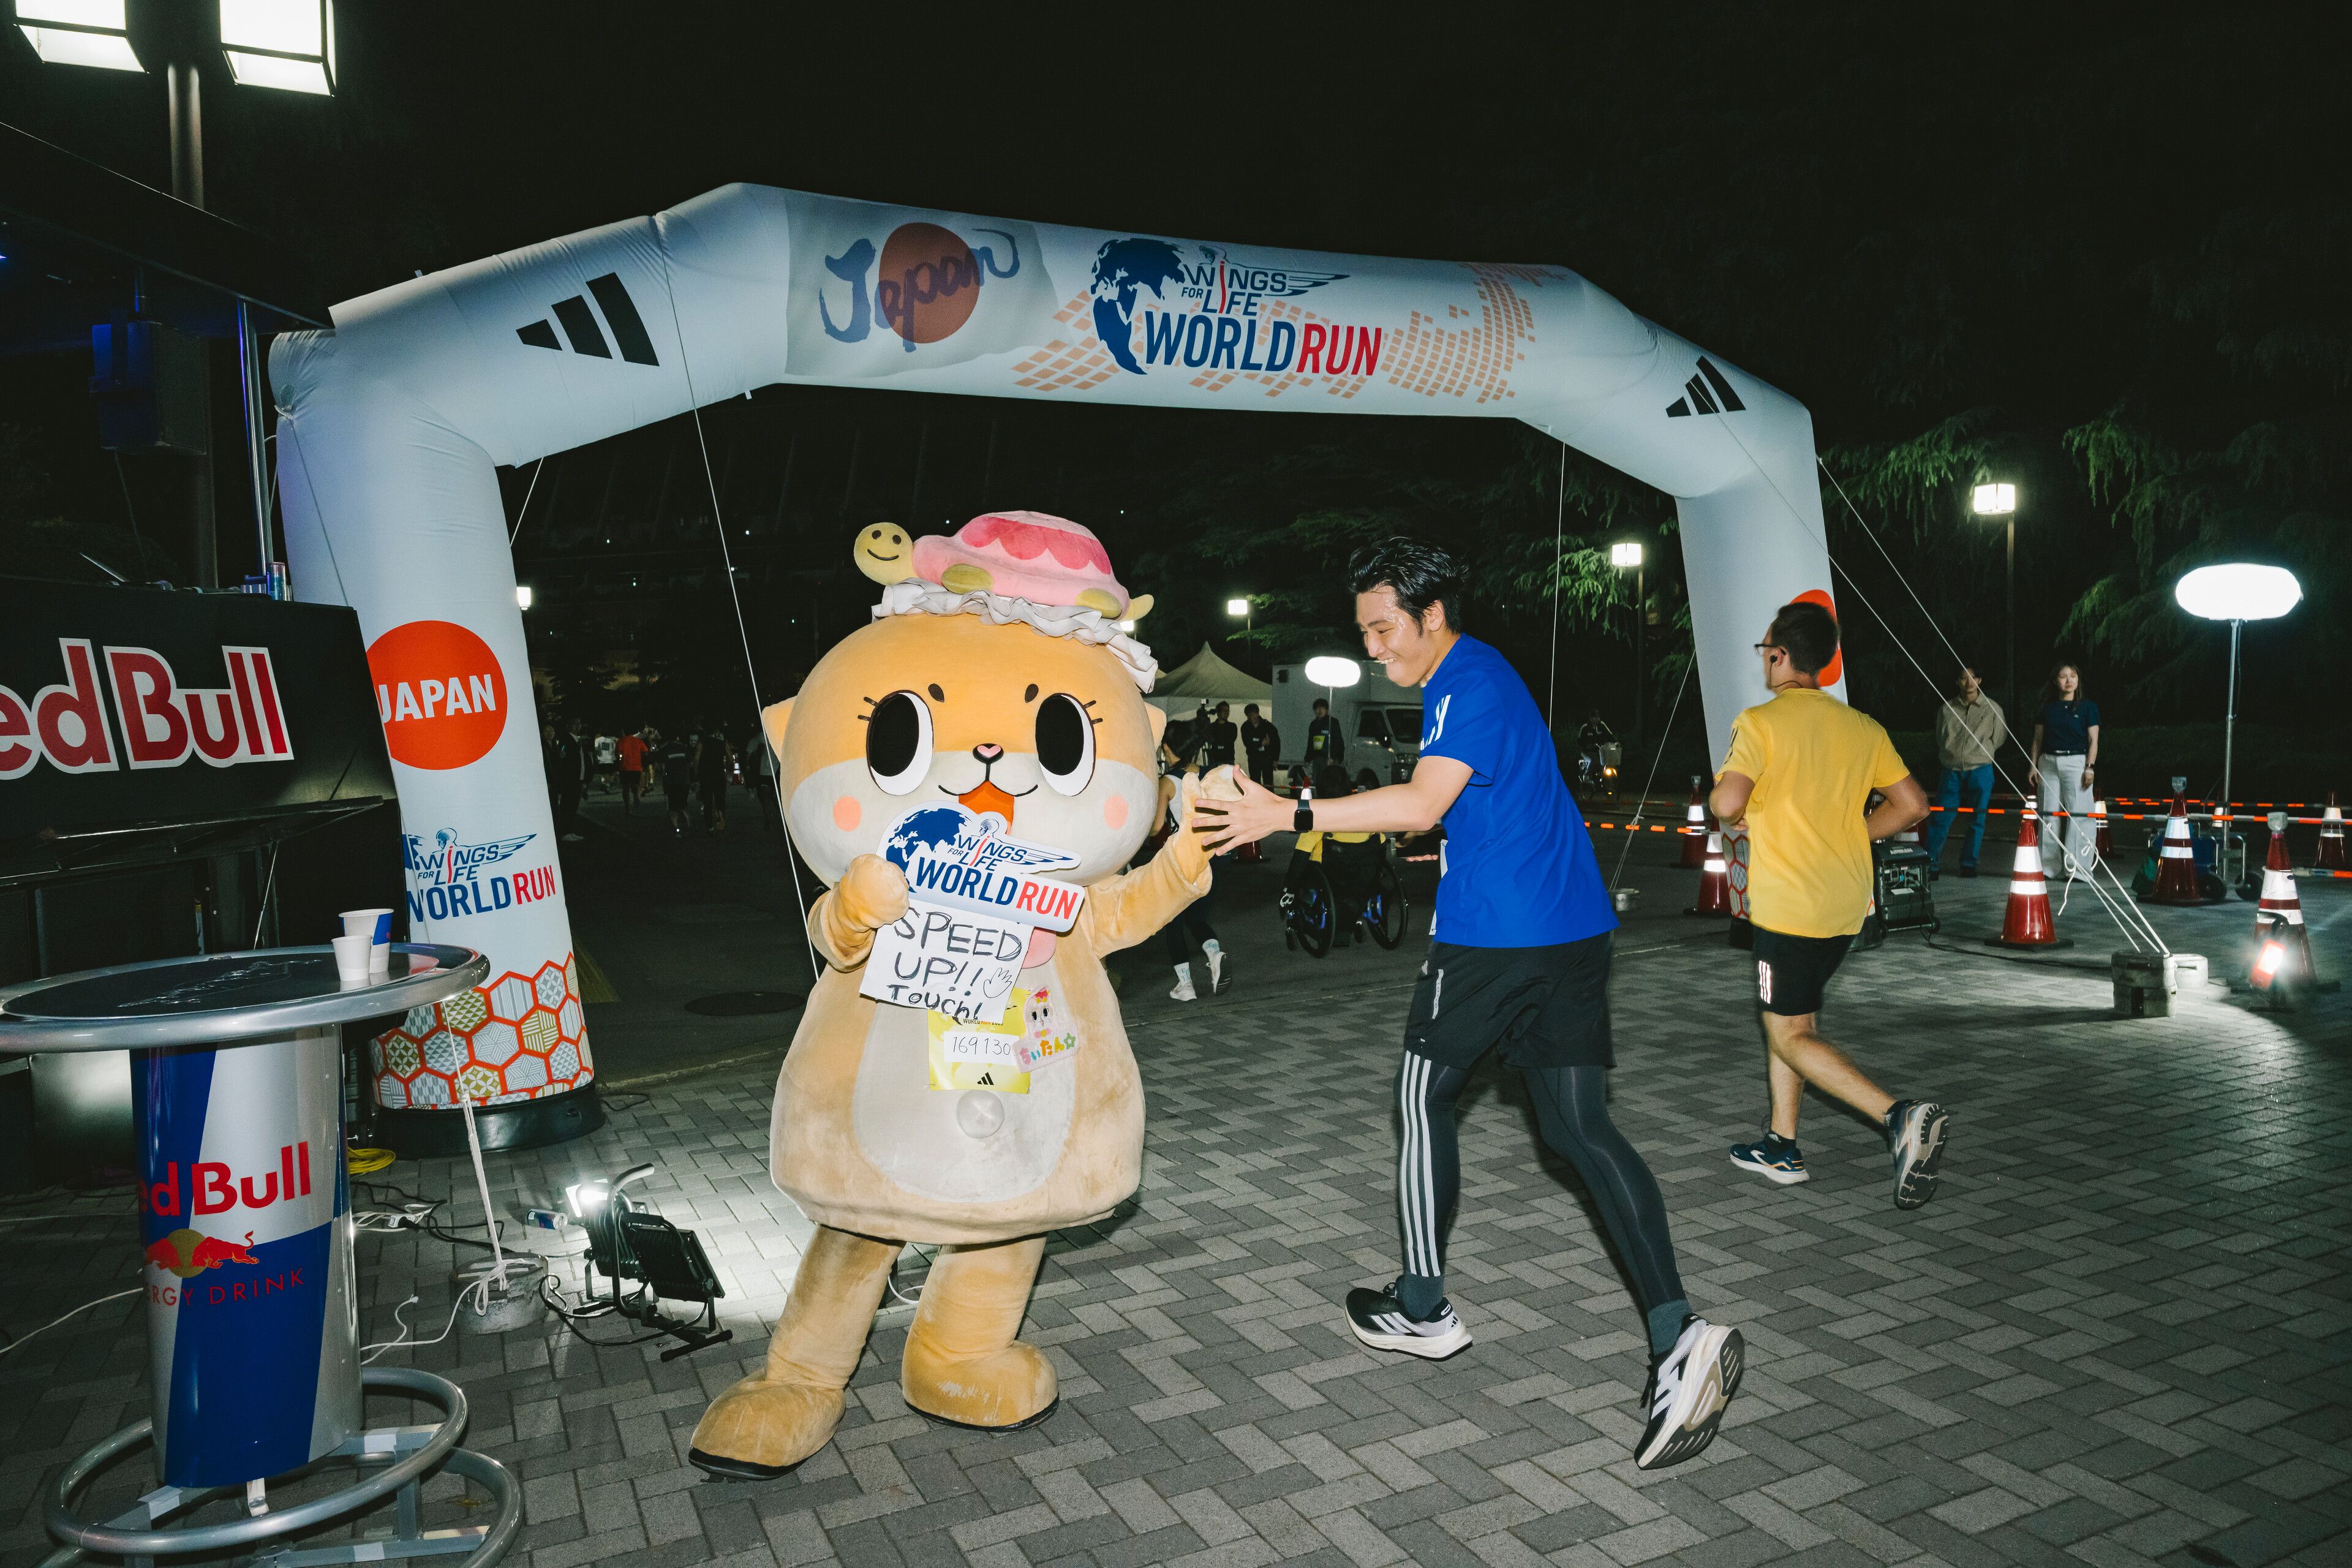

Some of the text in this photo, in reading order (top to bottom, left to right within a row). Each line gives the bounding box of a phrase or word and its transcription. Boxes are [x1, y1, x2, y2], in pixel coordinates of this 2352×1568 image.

[1181, 287, 1204, 299] FOR
[1202, 288, 1262, 316] LIFE
[1145, 311, 1382, 376] WORLD RUN
[103, 646, 295, 769] Bull
[377, 674, 496, 724] JAPAN
[948, 848, 964, 856] FOR
[958, 851, 1003, 872] LIFE
[417, 870, 434, 880] FOR
[434, 864, 480, 886] LIFE
[512, 864, 556, 905] RUN
[916, 856, 1079, 920] WORLD RUN
[894, 907, 1023, 962] SPEED
[894, 952, 984, 997] UP!!
[191, 1140, 311, 1216] Bull
[209, 1268, 305, 1305] DRINK
